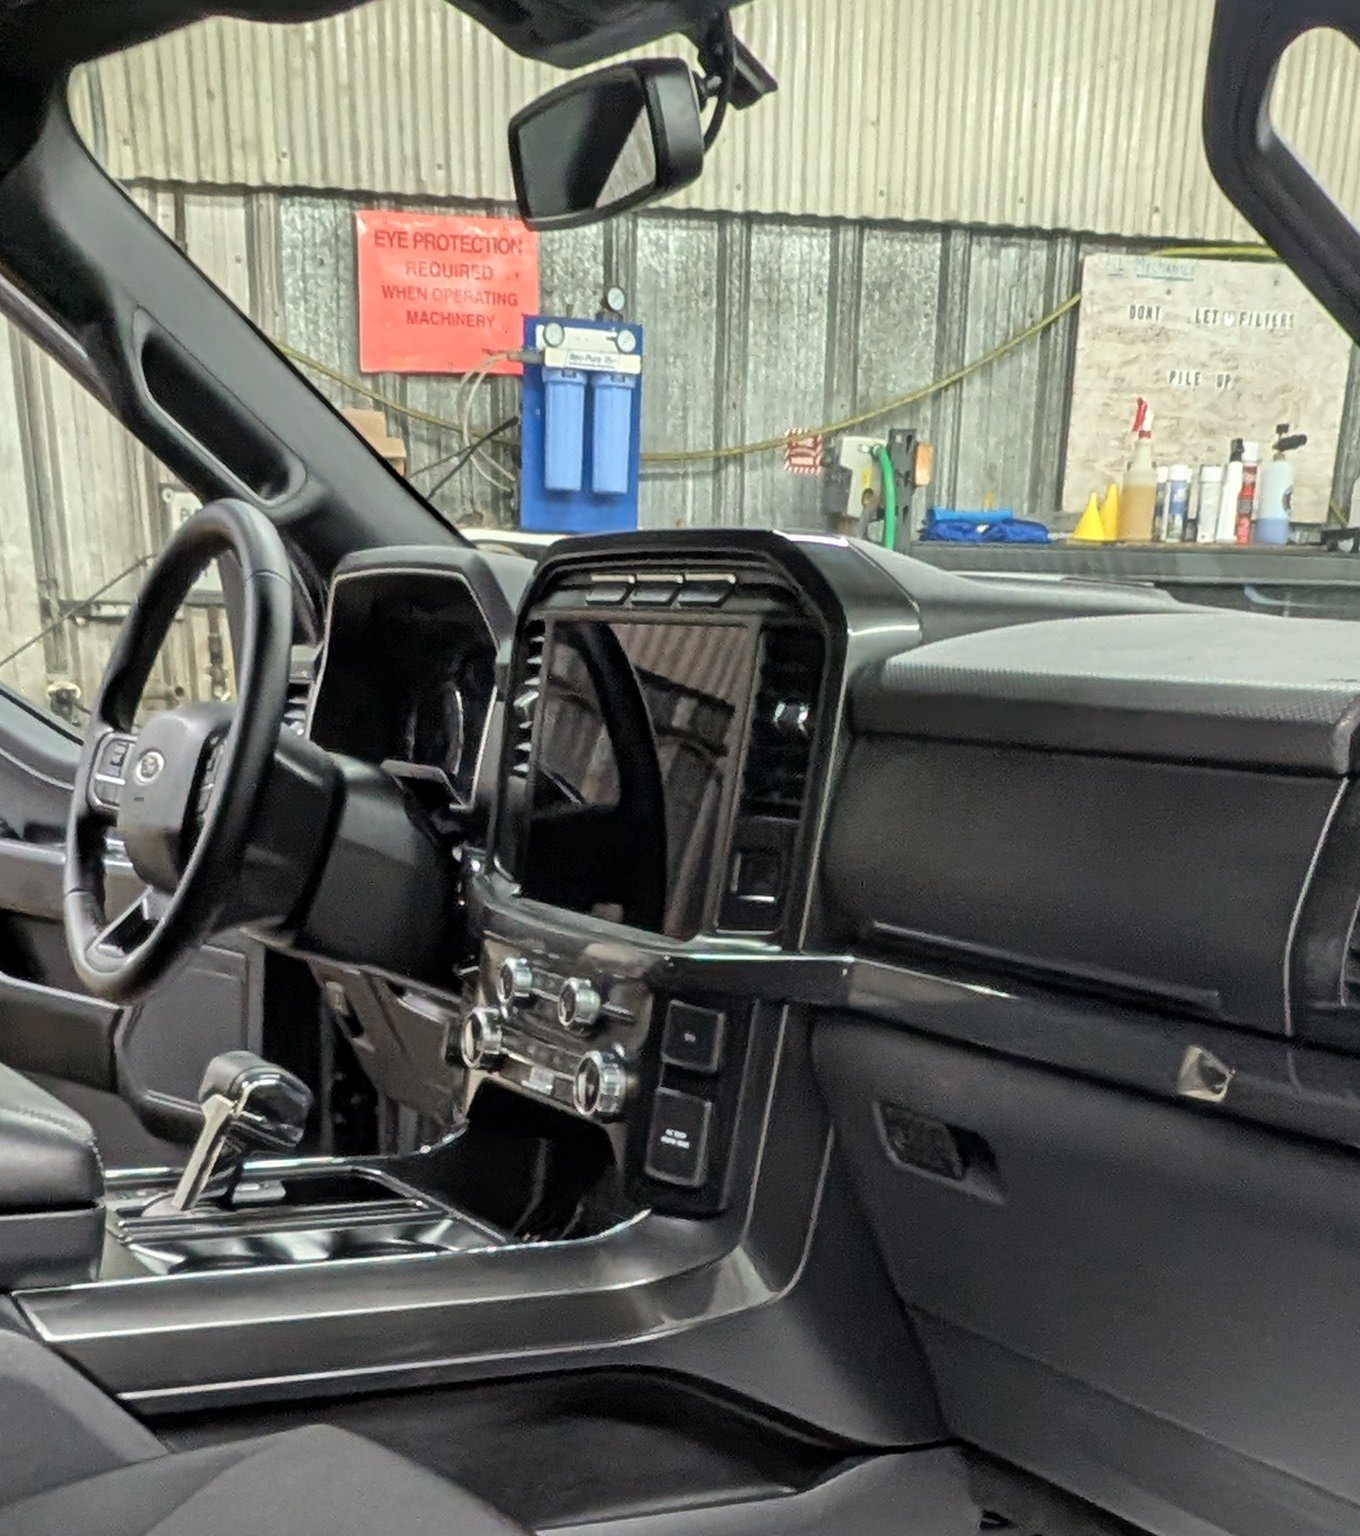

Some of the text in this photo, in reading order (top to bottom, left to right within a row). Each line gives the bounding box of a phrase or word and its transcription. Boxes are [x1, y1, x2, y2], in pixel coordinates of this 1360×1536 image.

[375, 230, 522, 255] EYE PROTECTION
[406, 261, 493, 281] REQUIRED
[382, 285, 518, 306] WHEN OPERATING
[406, 311, 496, 328] MACHINERY
[1129, 305, 1161, 321] DONT
[1195, 308, 1218, 325] LET
[1169, 370, 1201, 386] PILE
